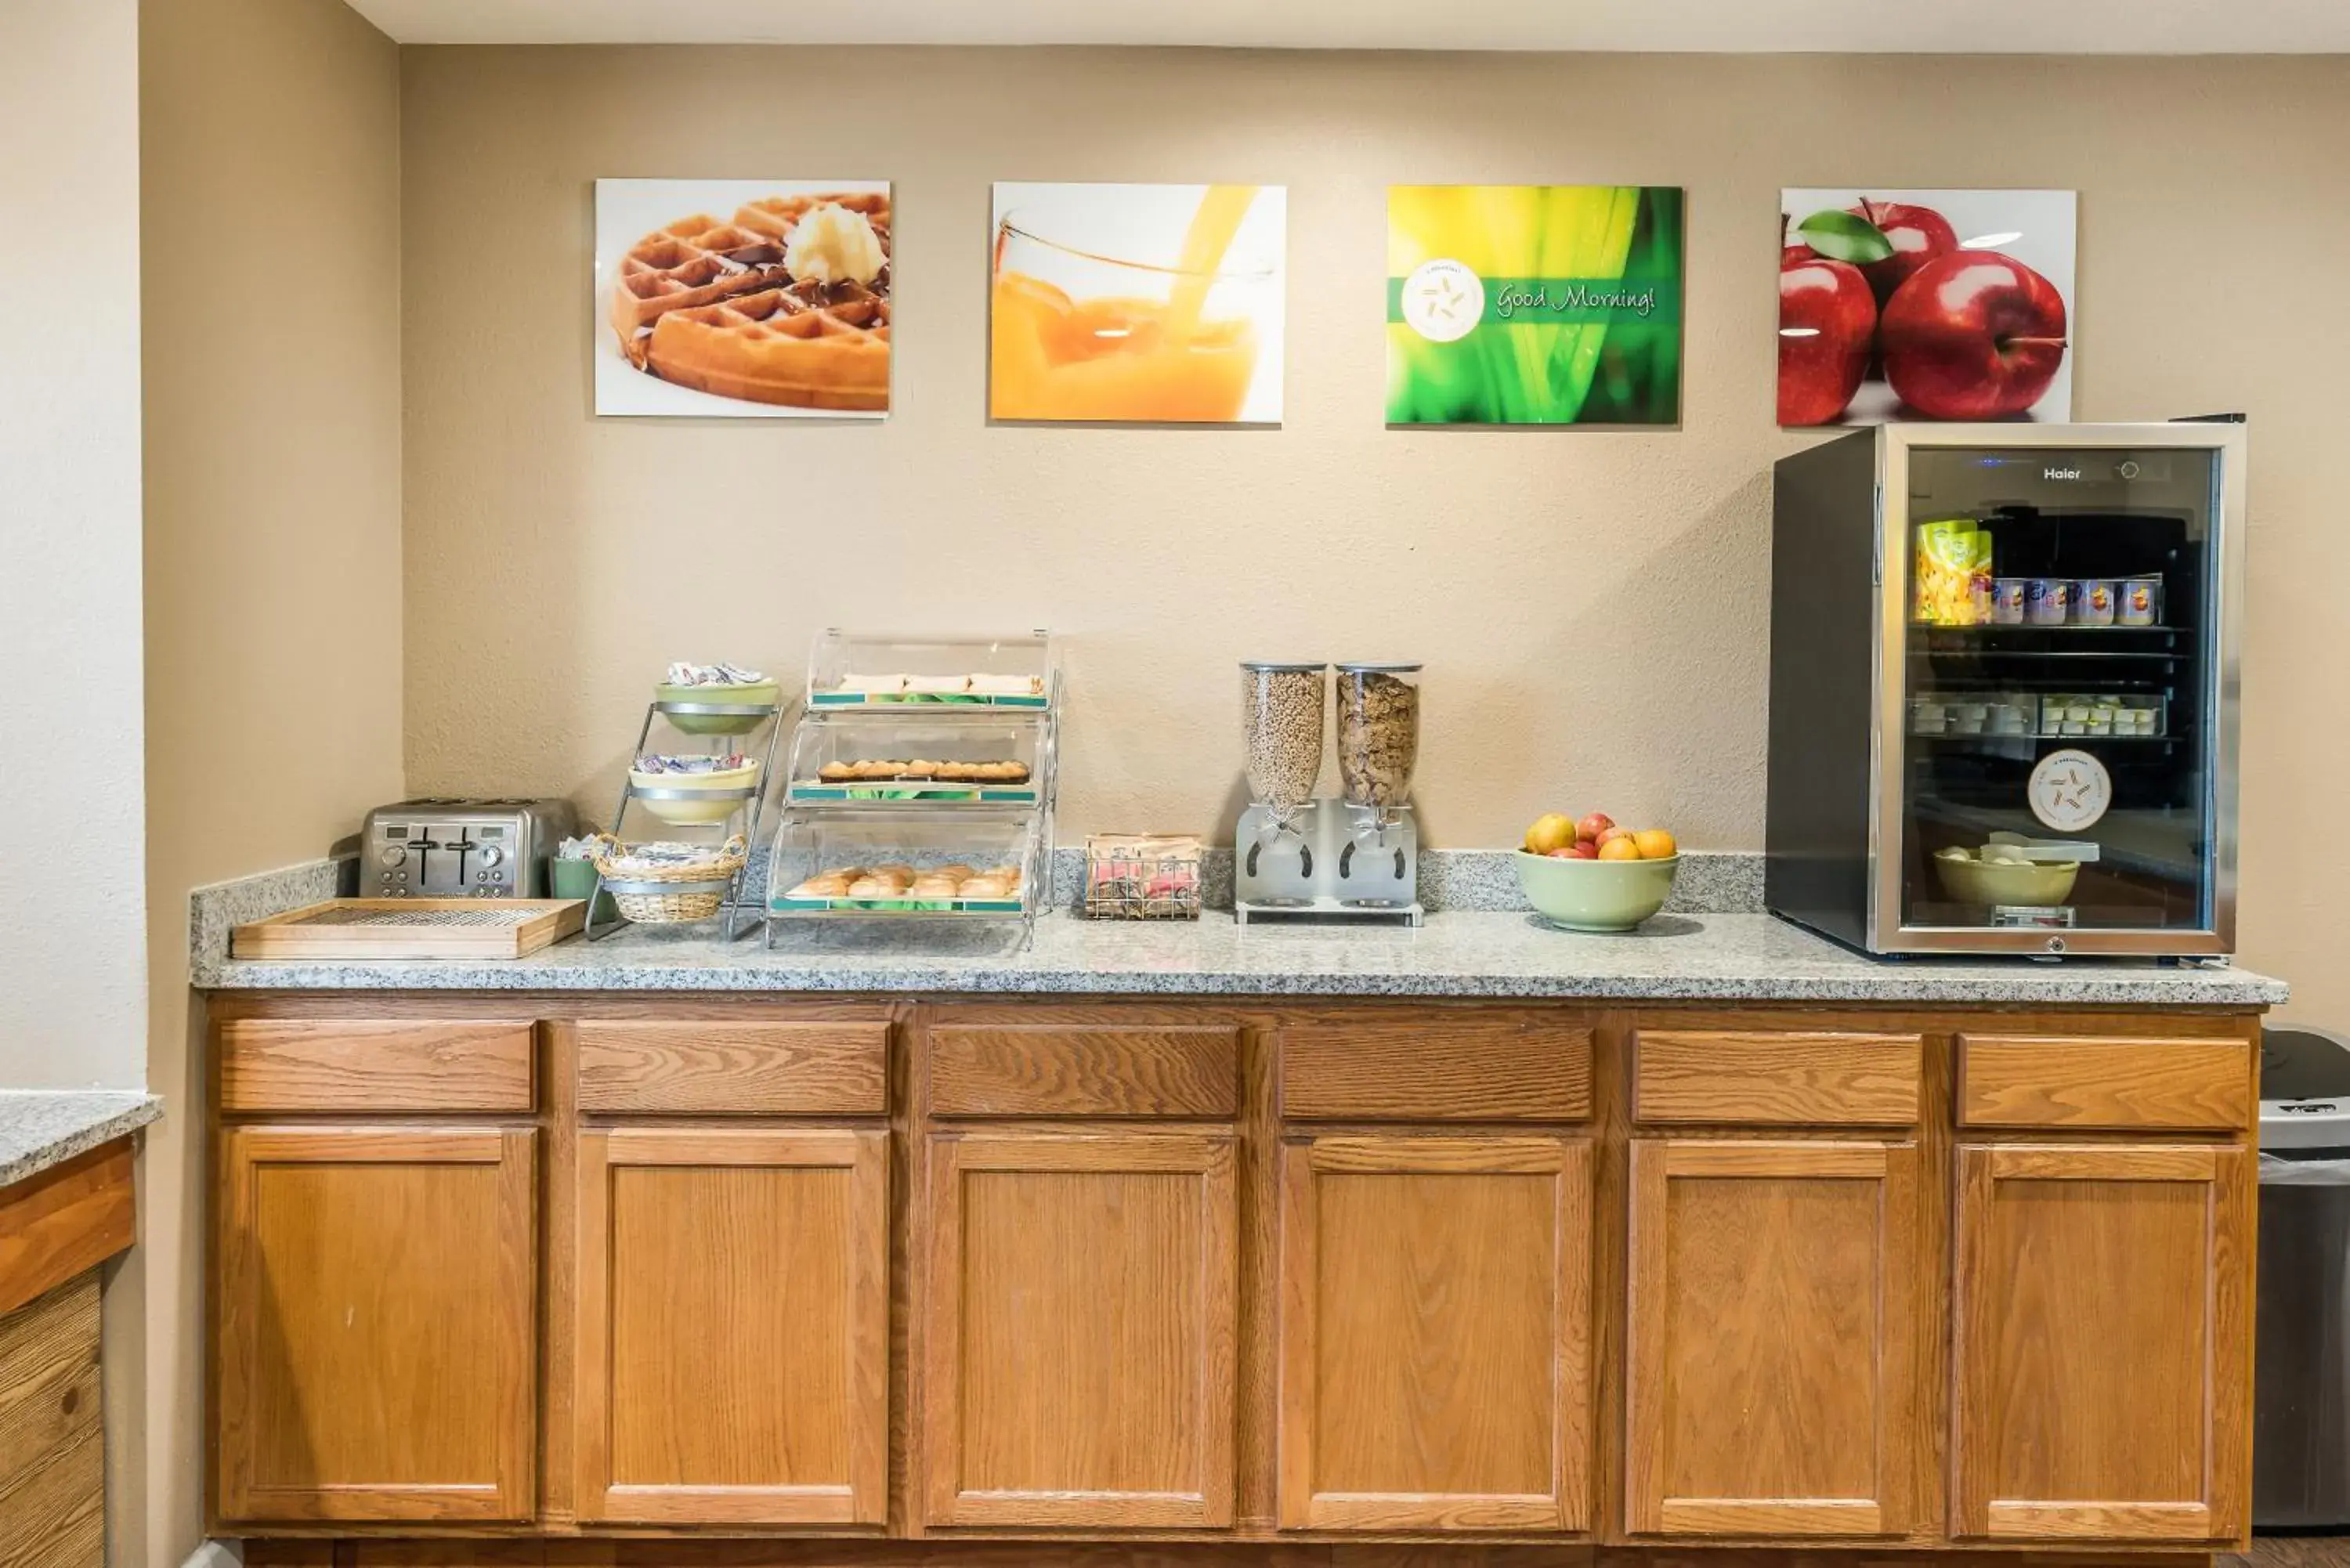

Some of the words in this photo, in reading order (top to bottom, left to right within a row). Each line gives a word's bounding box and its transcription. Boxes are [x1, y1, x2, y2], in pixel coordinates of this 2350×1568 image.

[1497, 284, 1546, 317] Good
[1552, 284, 1655, 316] Morning!
[2044, 468, 2081, 479] Haier
